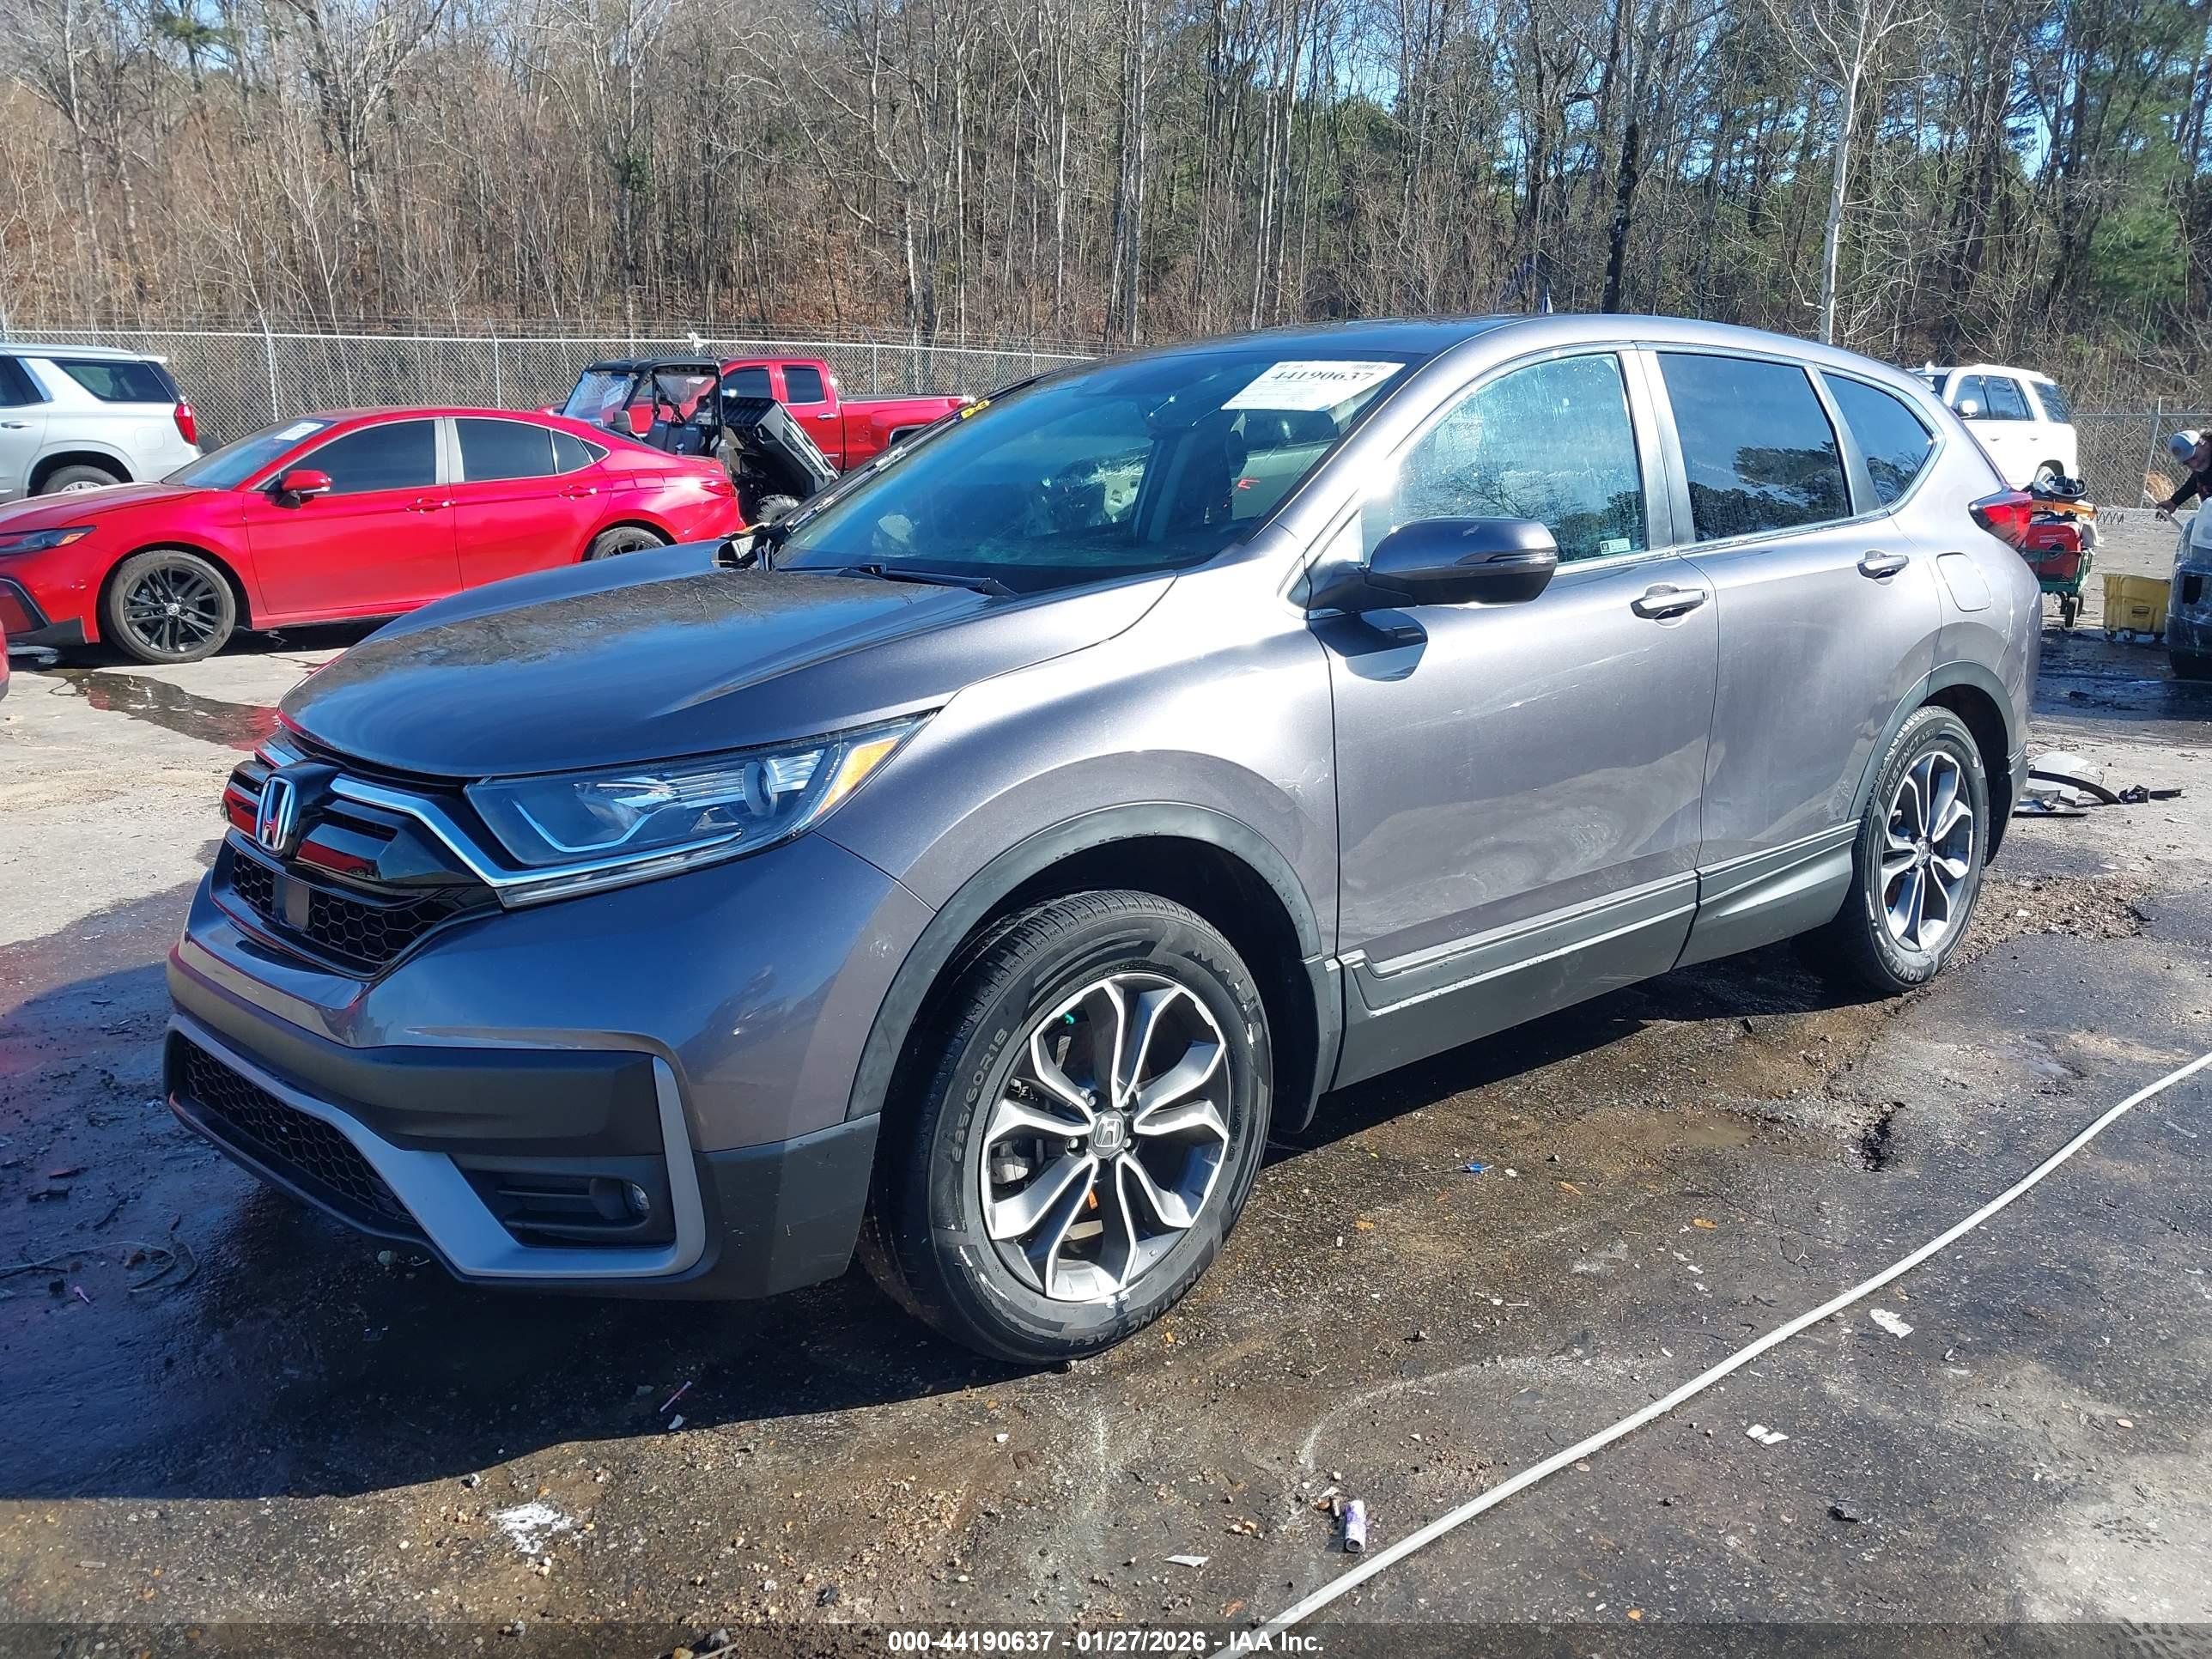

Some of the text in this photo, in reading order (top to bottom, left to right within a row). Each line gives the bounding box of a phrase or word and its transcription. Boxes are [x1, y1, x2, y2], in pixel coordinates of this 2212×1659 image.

[1270, 371, 1375, 382] 44190637
[1886, 734, 1919, 797] INSTINCT
[951, 1028, 1008, 1162] 235/60R18
